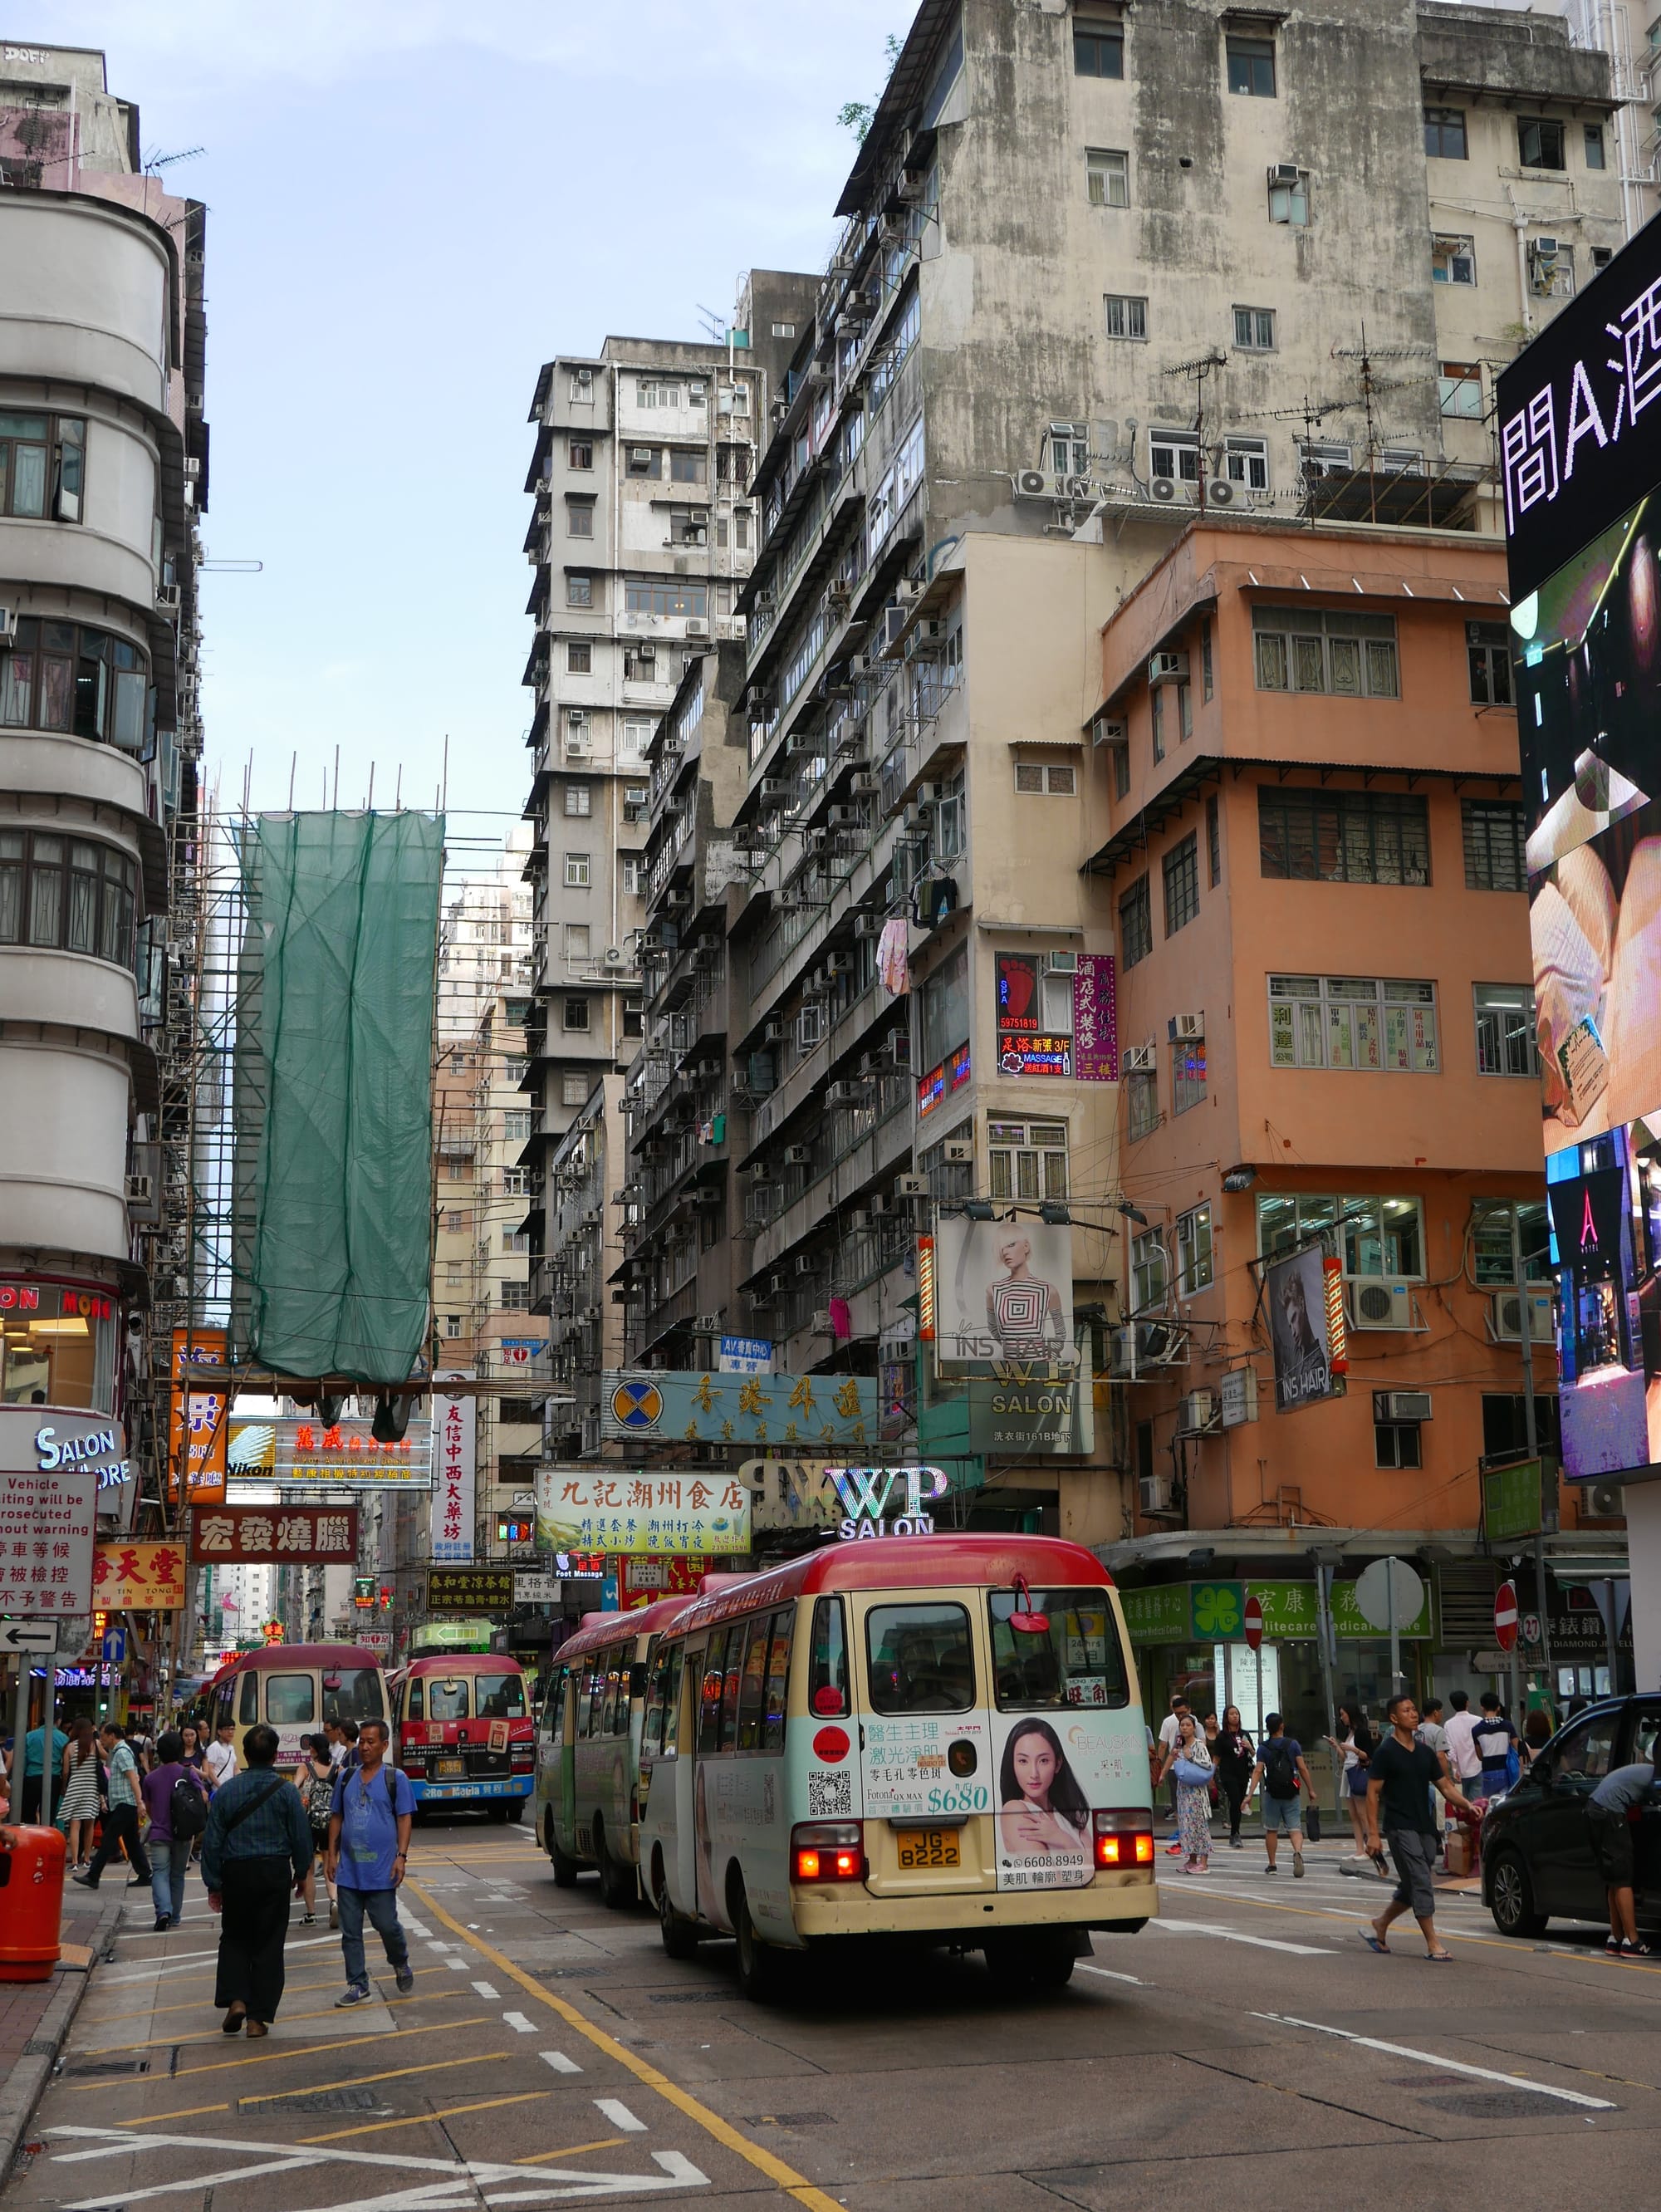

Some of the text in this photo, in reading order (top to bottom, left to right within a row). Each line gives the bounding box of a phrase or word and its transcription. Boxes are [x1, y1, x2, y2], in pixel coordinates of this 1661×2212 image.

[1000, 979, 1008, 1004] SPA
[1000, 1018, 1037, 1029] 59751819
[1055, 1040, 1070, 1052] 3/F
[1023, 1054, 1062, 1064] MASSAGE
[1282, 1366, 1327, 1402] INS HAIR
[992, 1395, 1072, 1415] SALON
[993, 1431, 1072, 1443] 洗衣街161B地下
[37, 1427, 115, 1469] SALON
[227, 1464, 273, 1477] Nikon
[443, 1404, 464, 1541] 友信中西大藥坊
[8, 1478, 59, 1490] Vehicle
[39, 1494, 63, 1505] will
[66, 1494, 83, 1505] be
[560, 1479, 745, 1511] 九記潮州食店
[824, 1465, 948, 1521] WP
[33, 1524, 90, 1537] warning
[581, 1518, 705, 1533] 精選套餐 潮州打冷
[198, 1515, 351, 1552] 宏發燒臘
[647, 1536, 705, 1550] 晚飯宵夜
[574, 1570, 604, 1578] Massage
[0, 1590, 78, 1608] 不予警告
[1554, 1640, 1598, 1649] DIAMOND
[868, 1722, 940, 1743] 醫生主理
[1076, 1734, 1143, 1750] BEAUSKIN
[870, 1767, 941, 1782] 零毛孔 零色斑
[867, 1788, 893, 1800] Fotona
[906, 1792, 923, 1800] MAX
[928, 1787, 988, 1815] $680
[914, 1832, 943, 1849] JG
[901, 1847, 958, 1866] 8222
[1024, 1854, 1084, 1868] 6608 8949
[1002, 1870, 1084, 1886] 美肌 輪廓 塑身
